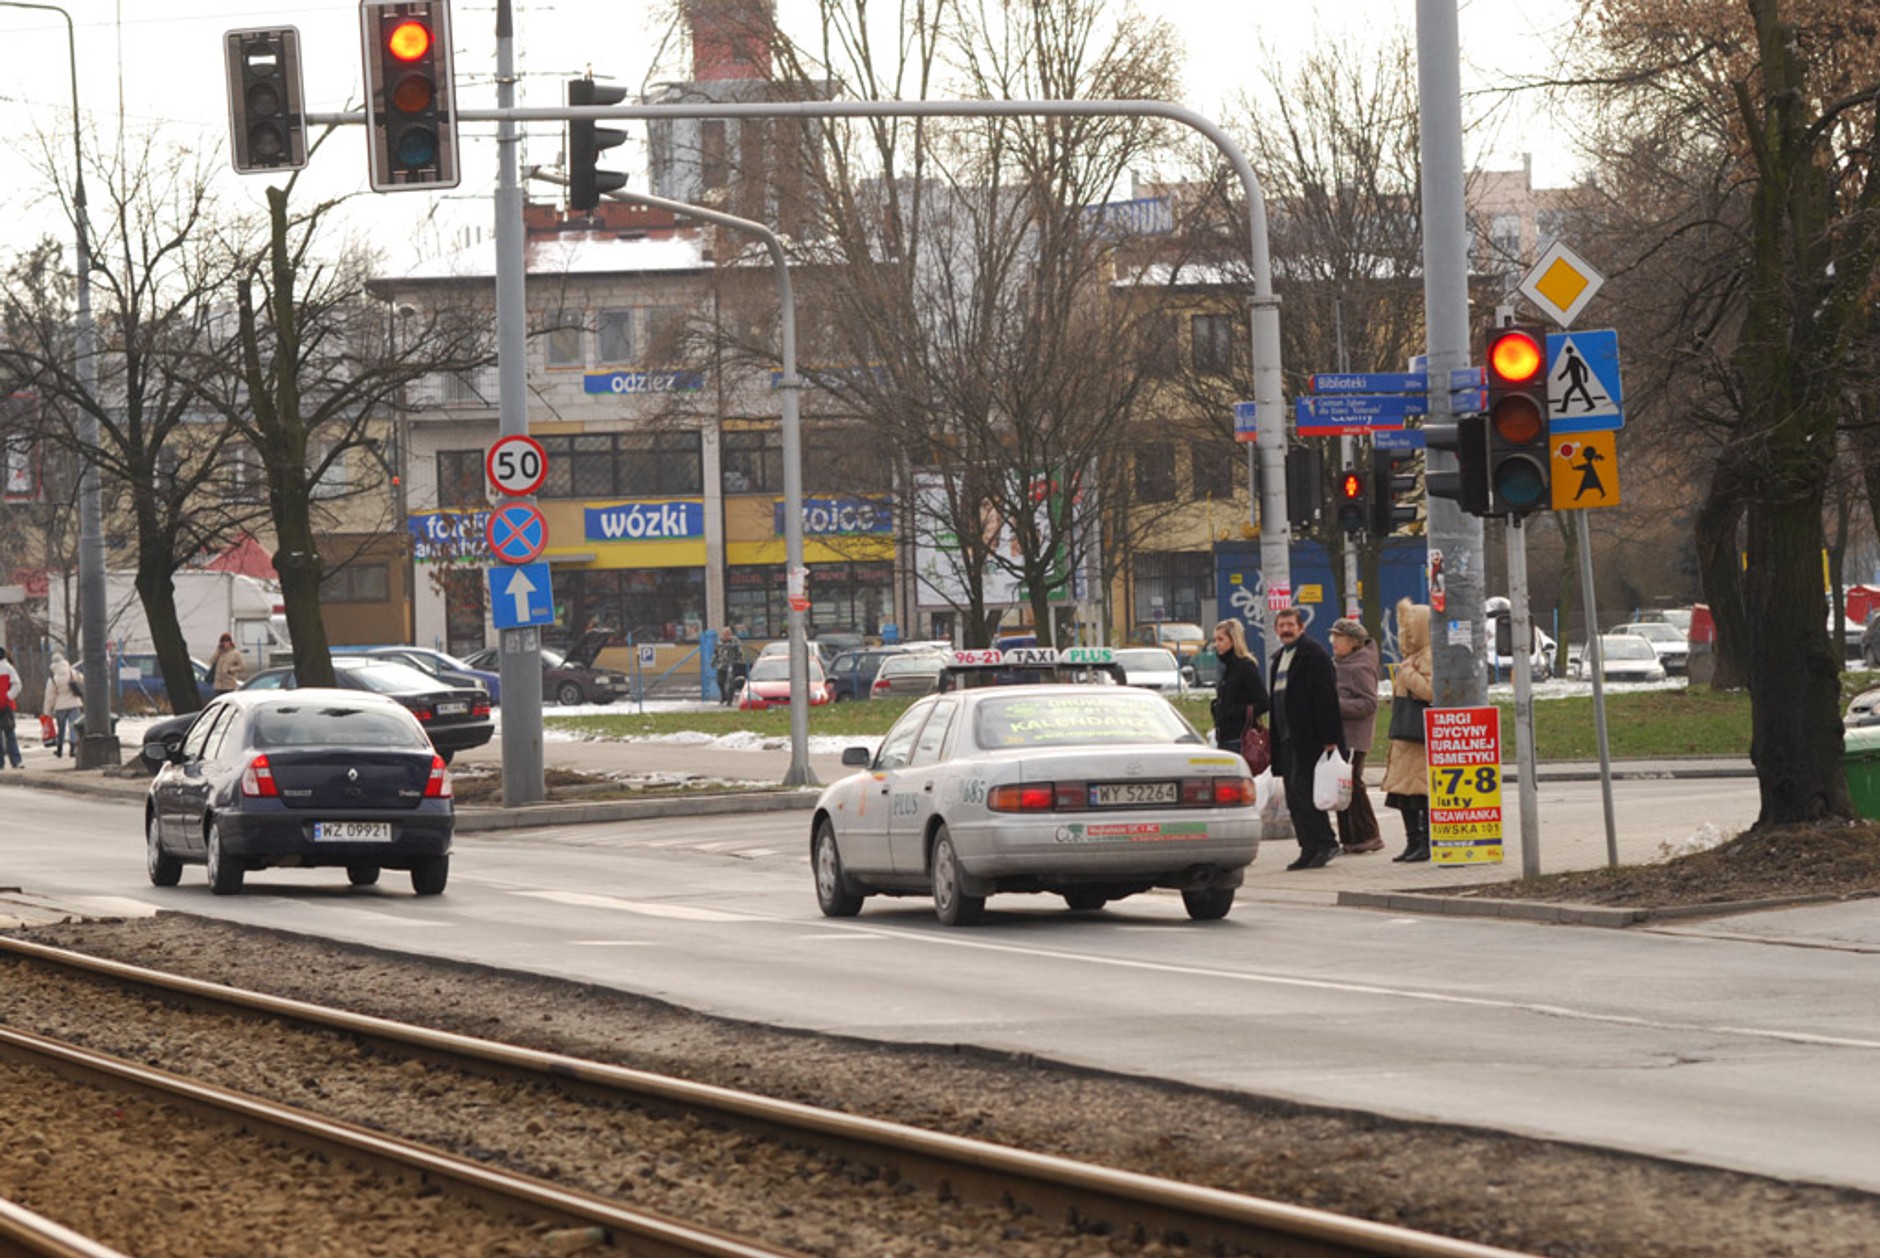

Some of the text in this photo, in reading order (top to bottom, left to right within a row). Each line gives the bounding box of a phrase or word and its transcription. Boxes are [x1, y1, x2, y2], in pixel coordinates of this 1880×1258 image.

[1318, 376, 1367, 389] Biblioteki
[498, 451, 539, 479] 50
[601, 504, 687, 538] wózki
[955, 650, 1112, 664] 96-21 TAXI PLUS
[1100, 783, 1175, 801] WY 52264
[893, 792, 918, 816] PLUS
[1437, 796, 1472, 808] luty
[323, 823, 389, 838] WZ 09921
